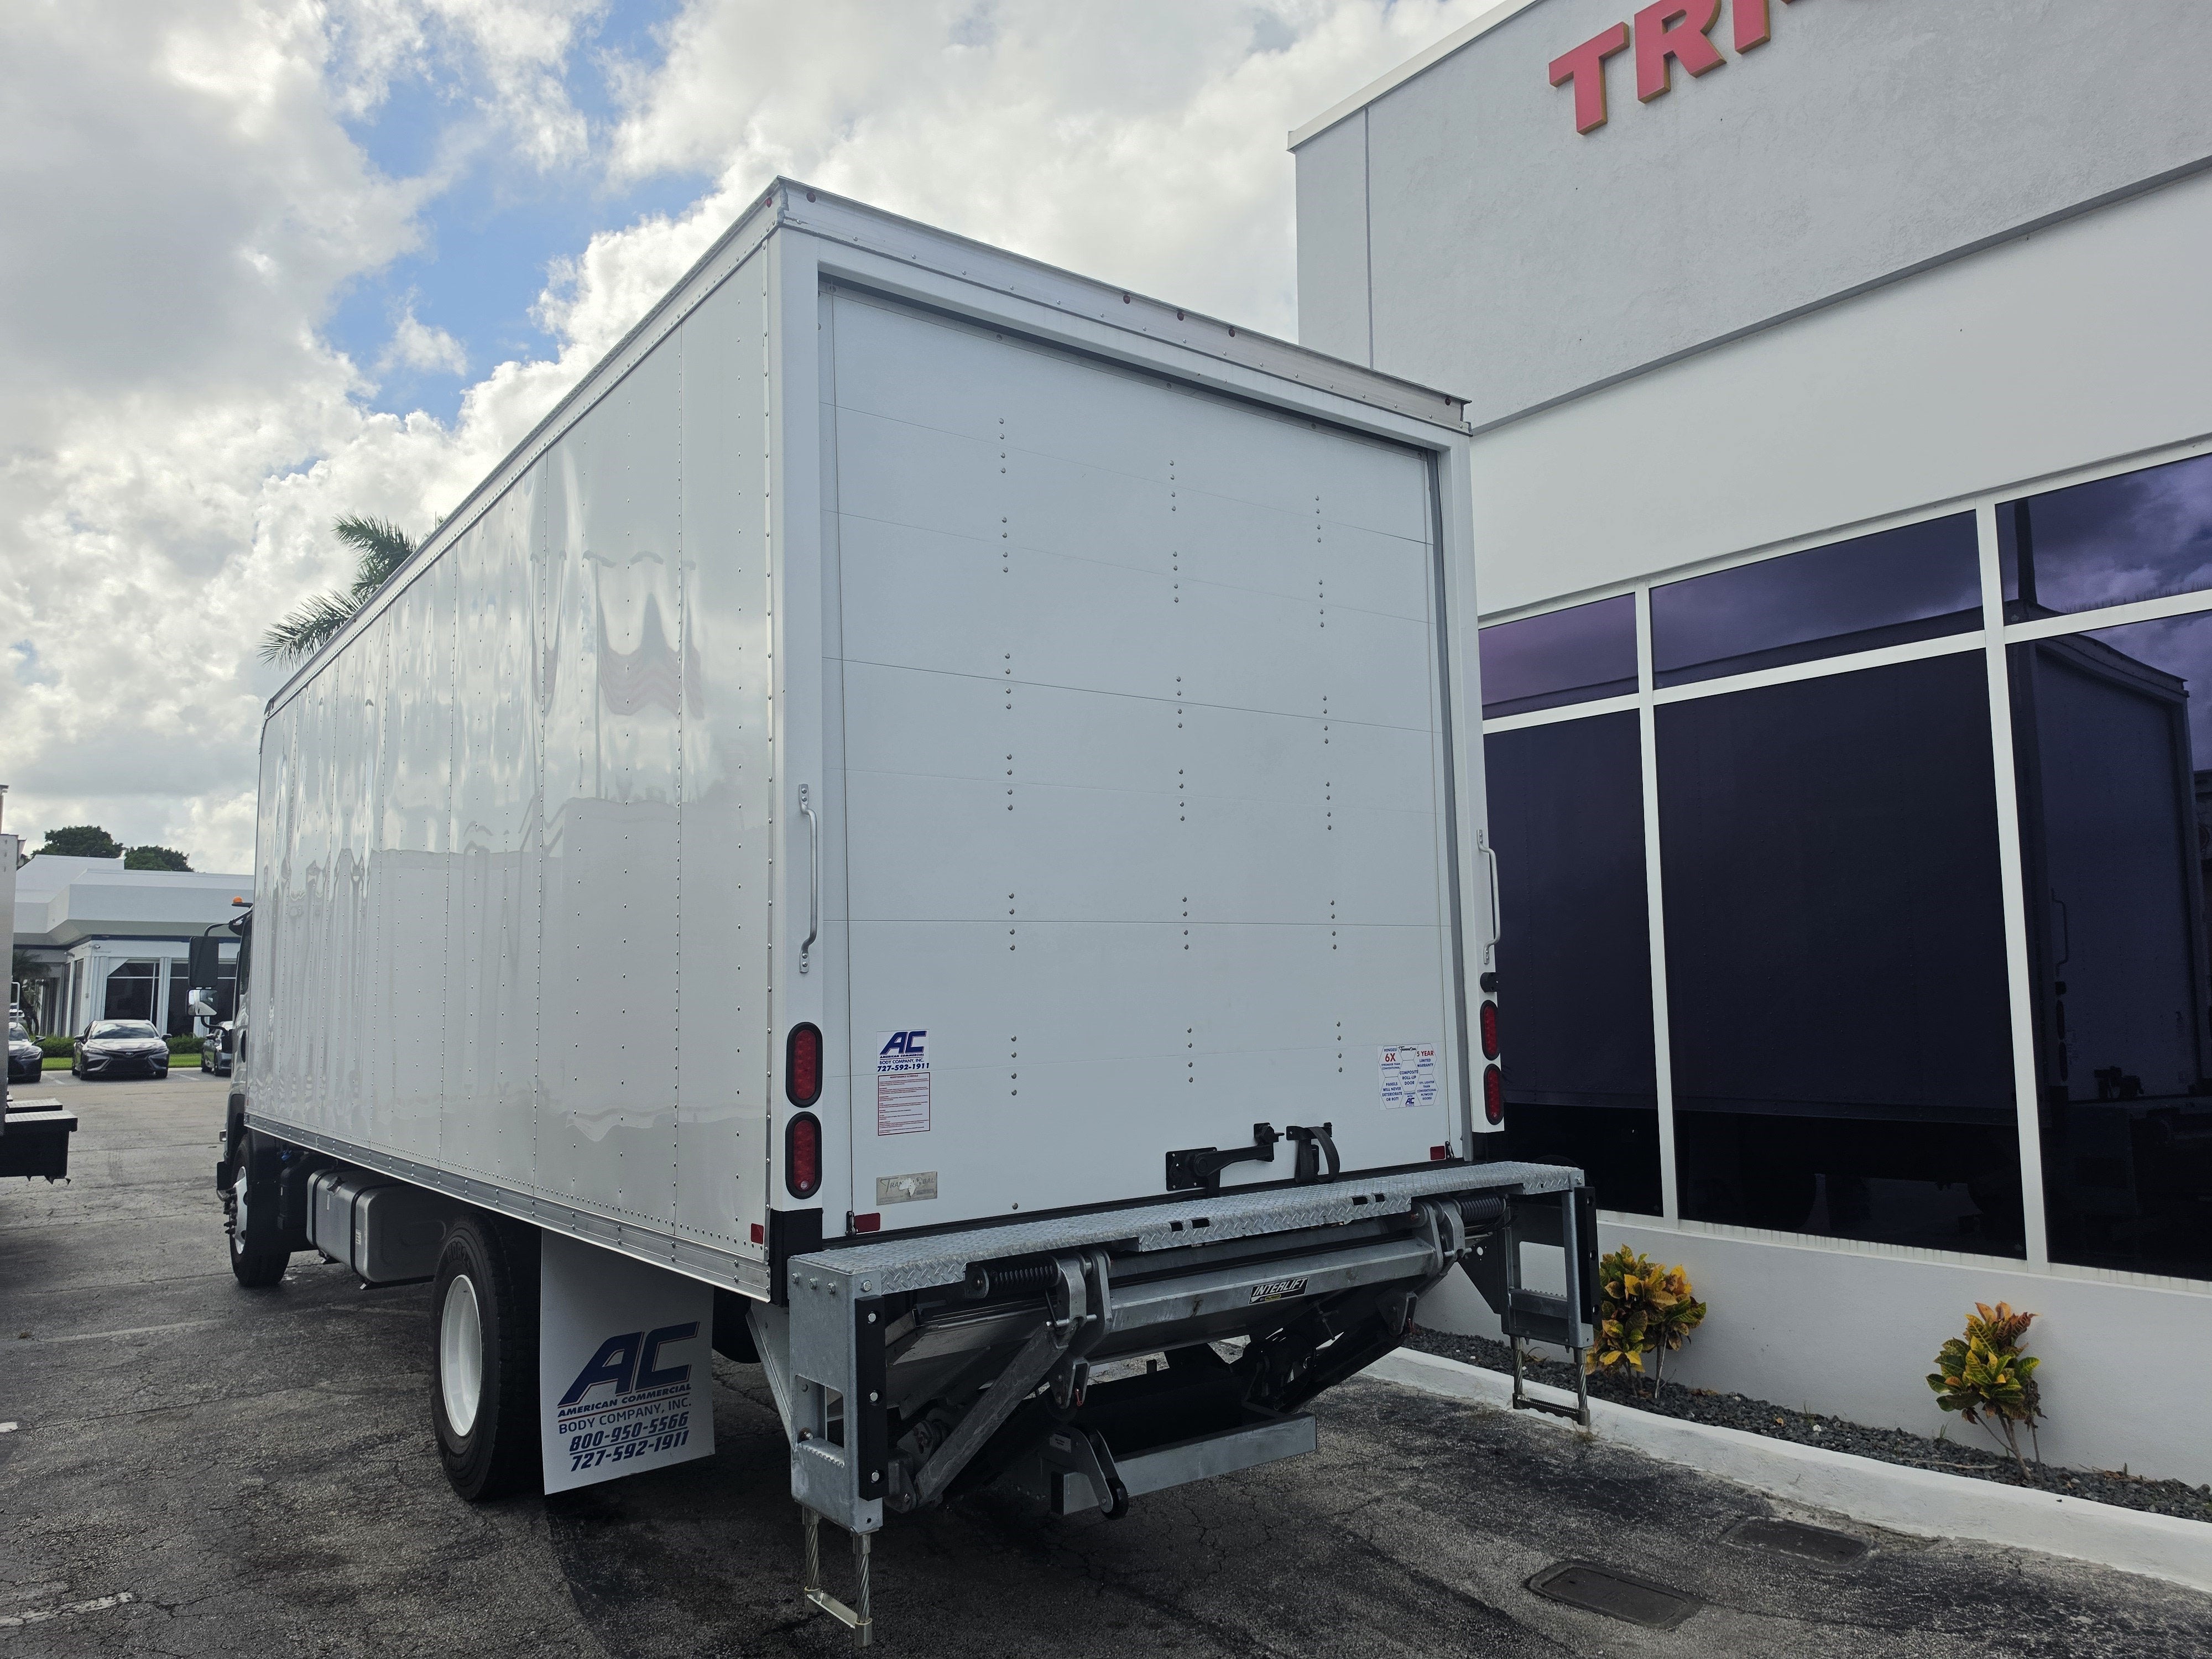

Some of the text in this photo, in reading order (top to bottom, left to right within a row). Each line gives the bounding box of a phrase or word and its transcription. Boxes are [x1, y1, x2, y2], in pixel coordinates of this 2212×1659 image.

[880, 1031, 927, 1055] AC
[1385, 1053, 1396, 1062] 6X
[877, 1063, 929, 1072] 727-592-1911
[1253, 1278, 1308, 1296] INTERLIFT
[557, 1321, 700, 1408] AC
[557, 1384, 691, 1417] AMERICAN COMMERCIAL
[559, 1397, 691, 1434] BODY COMPANY, INC.
[569, 1411, 690, 1452] 800-950-5566
[570, 1430, 690, 1472] 727-592-1911
